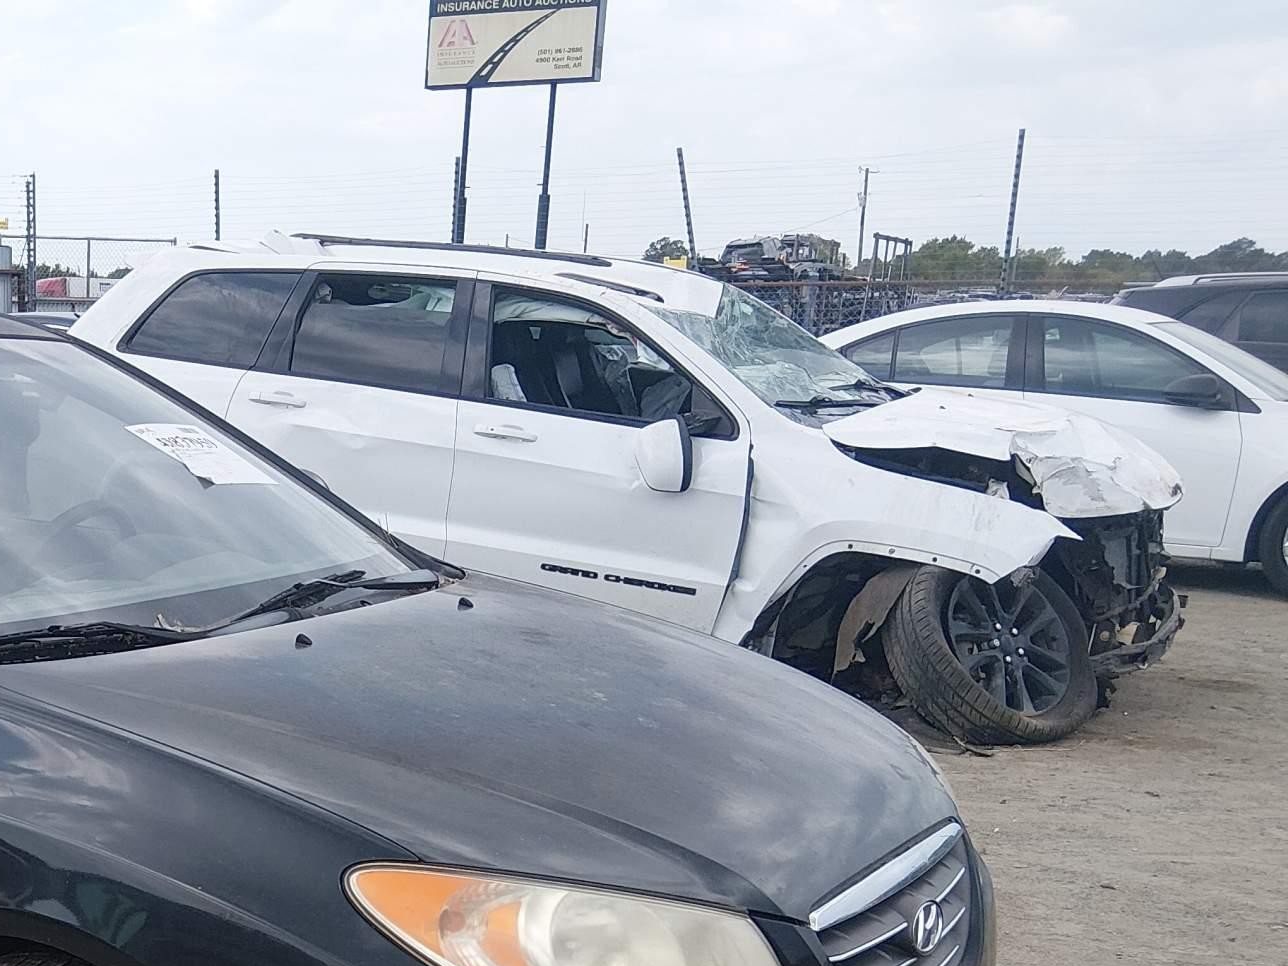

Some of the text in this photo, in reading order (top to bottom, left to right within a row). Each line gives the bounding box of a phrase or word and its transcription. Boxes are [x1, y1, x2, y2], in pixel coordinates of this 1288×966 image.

[437, 0, 499, 13] INSURANCE
[501, 0, 532, 8] AUTO
[540, 563, 598, 579] GRAND
